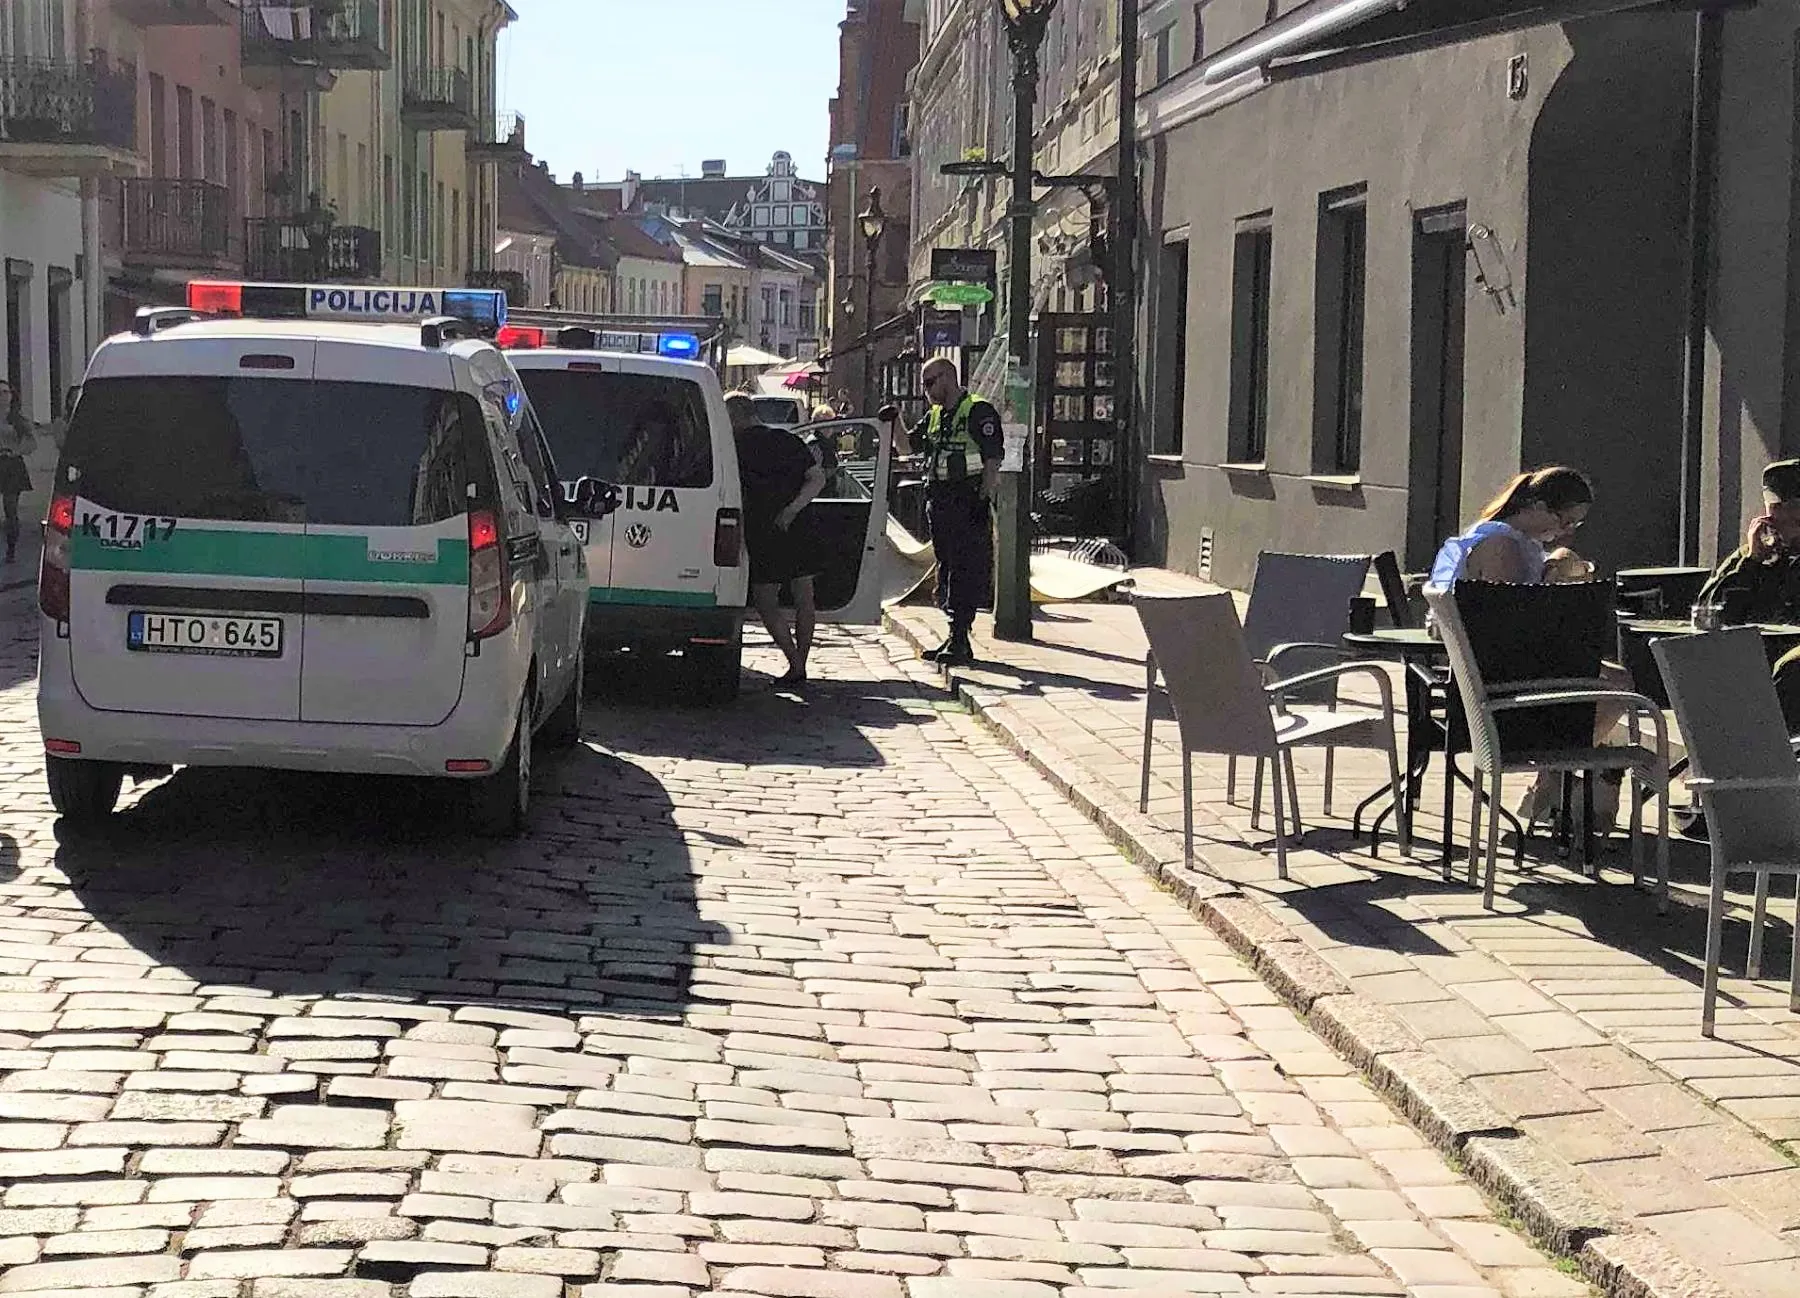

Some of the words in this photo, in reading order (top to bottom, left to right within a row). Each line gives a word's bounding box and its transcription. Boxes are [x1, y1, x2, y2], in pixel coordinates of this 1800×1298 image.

[311, 289, 437, 314] POLICIJA
[82, 512, 177, 542] K1717
[100, 538, 142, 550] DACIA
[147, 617, 206, 644] HTO
[225, 620, 275, 648] 645
